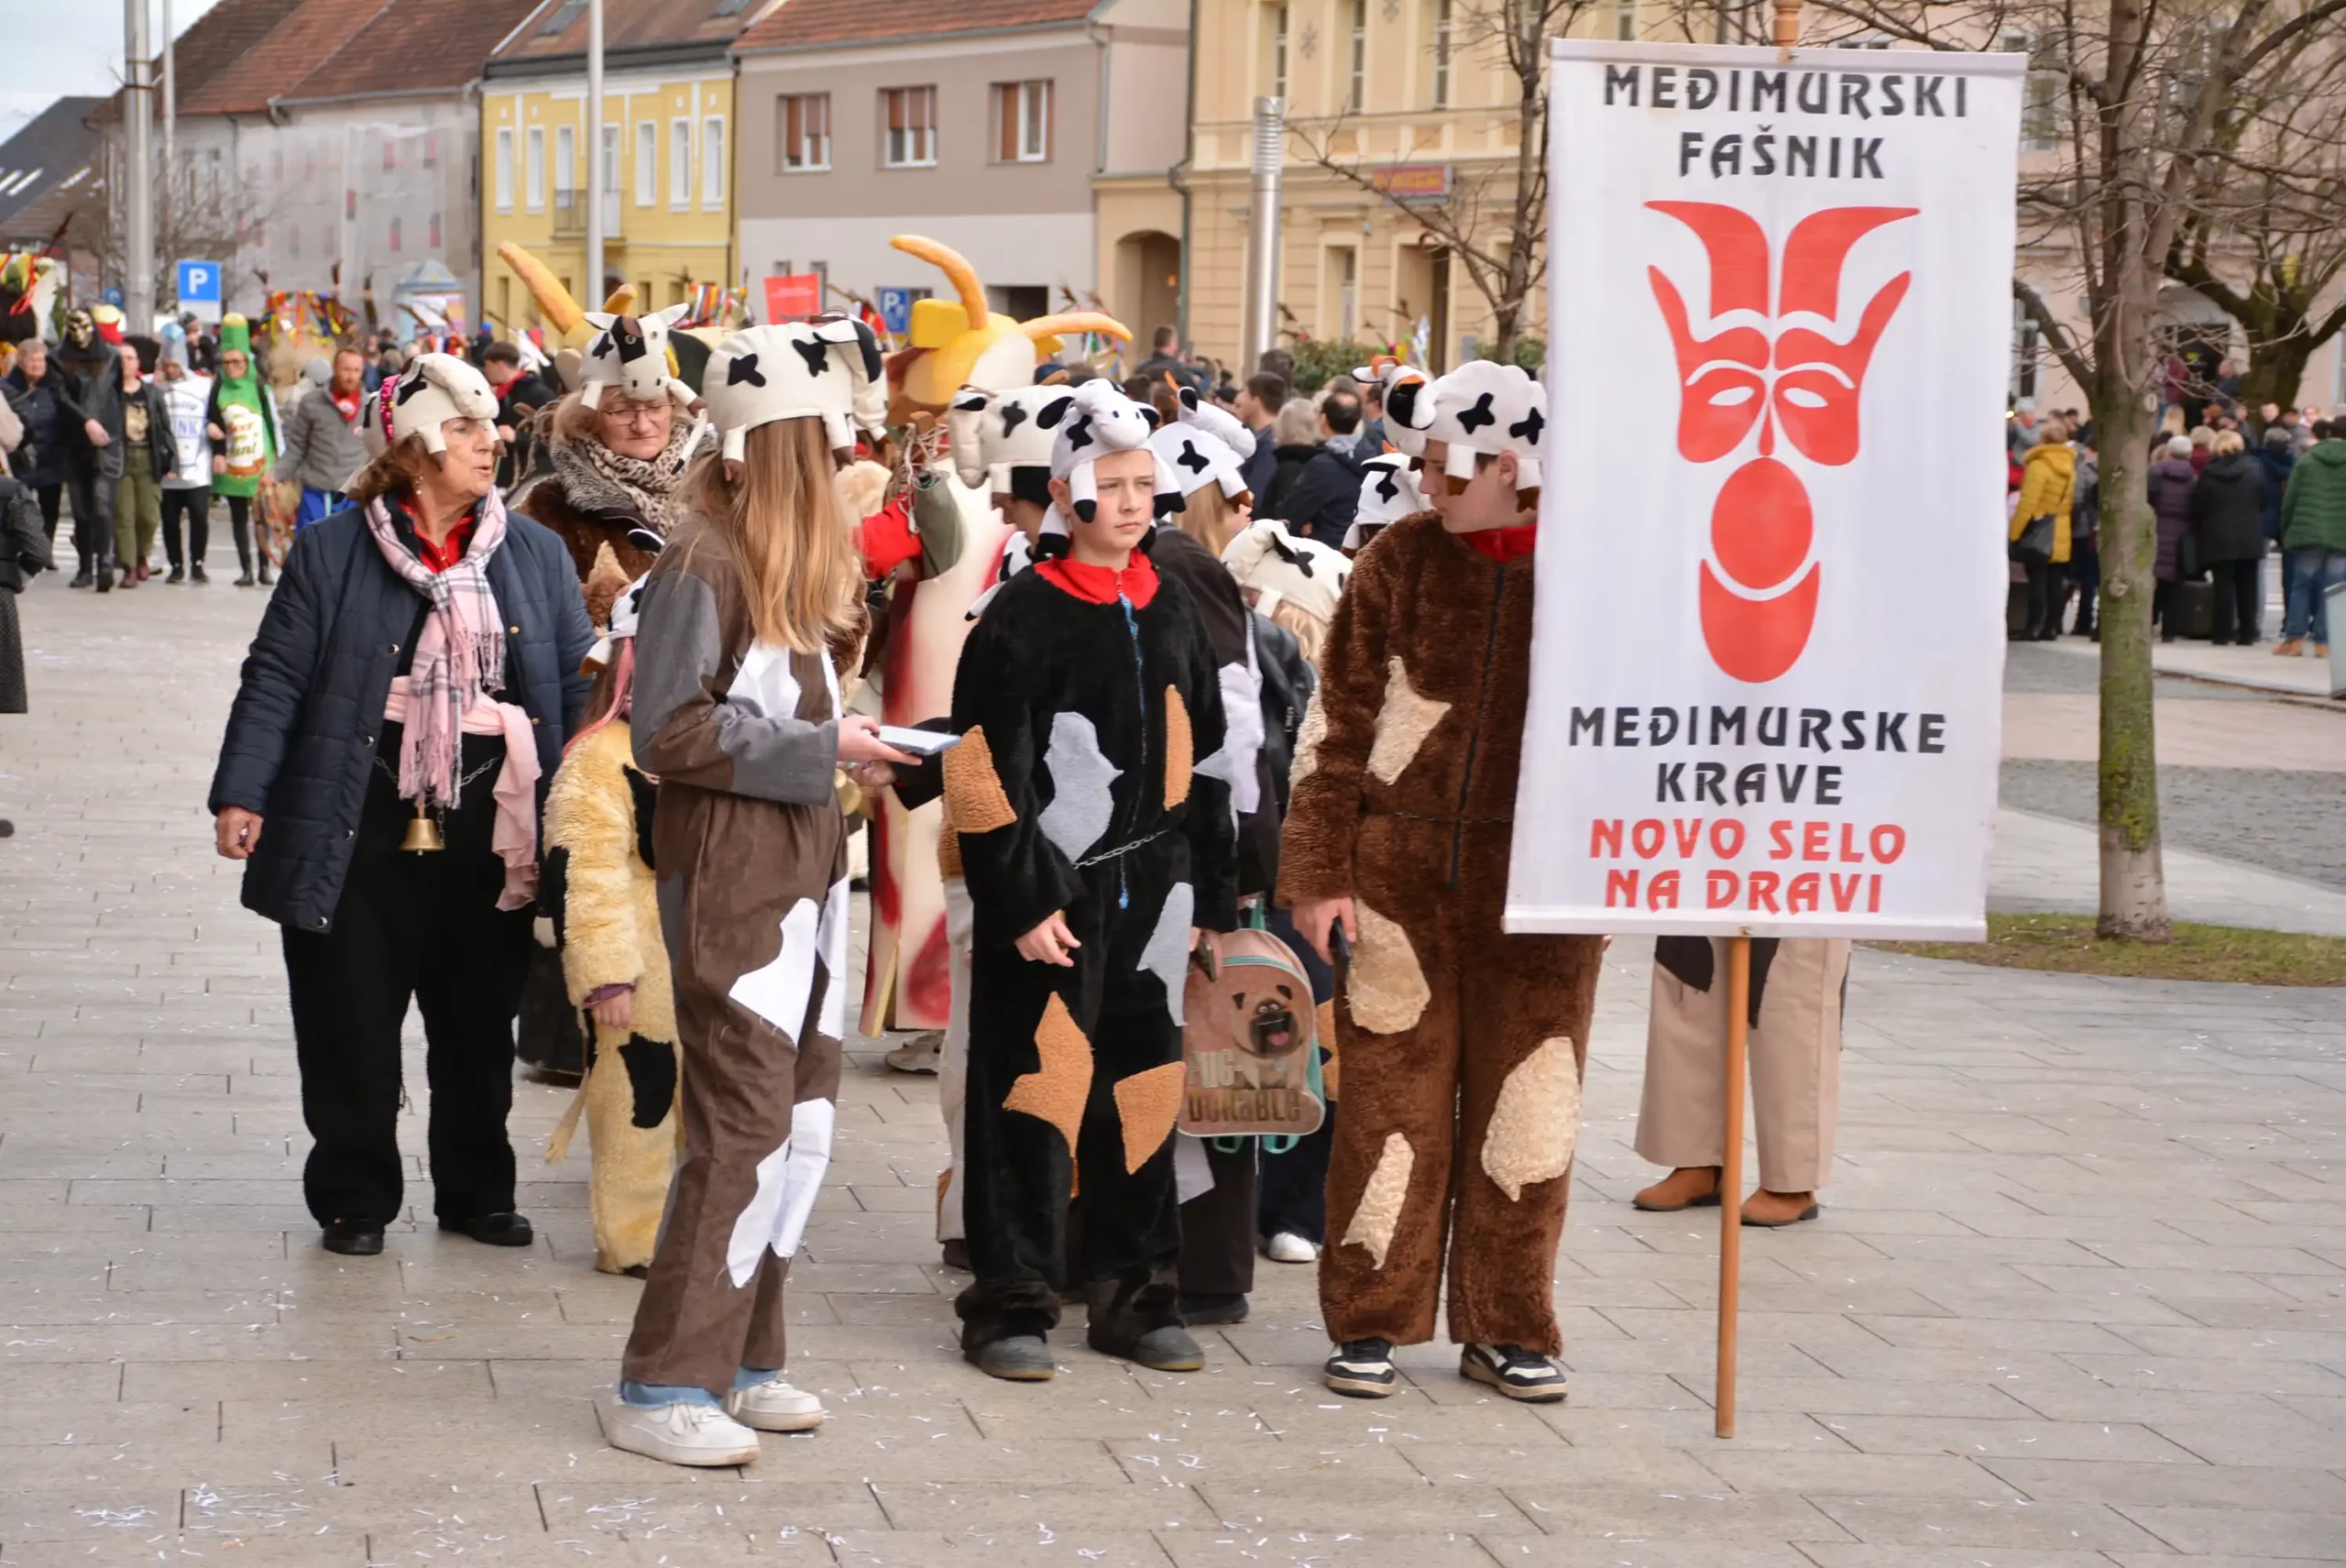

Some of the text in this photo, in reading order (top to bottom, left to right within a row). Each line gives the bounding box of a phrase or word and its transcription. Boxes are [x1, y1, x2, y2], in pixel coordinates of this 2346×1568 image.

[1605, 64, 1967, 120] MEĐIMURSKI
[1680, 124, 1884, 179] FAŠNIK
[189, 268, 208, 294] P
[1569, 705, 1946, 754] MEĐIMURSKE
[1656, 762, 1844, 807] KRAVE
[1590, 817, 1906, 865] NOVO SELO
[1605, 868, 1882, 916] NA DRAVI
